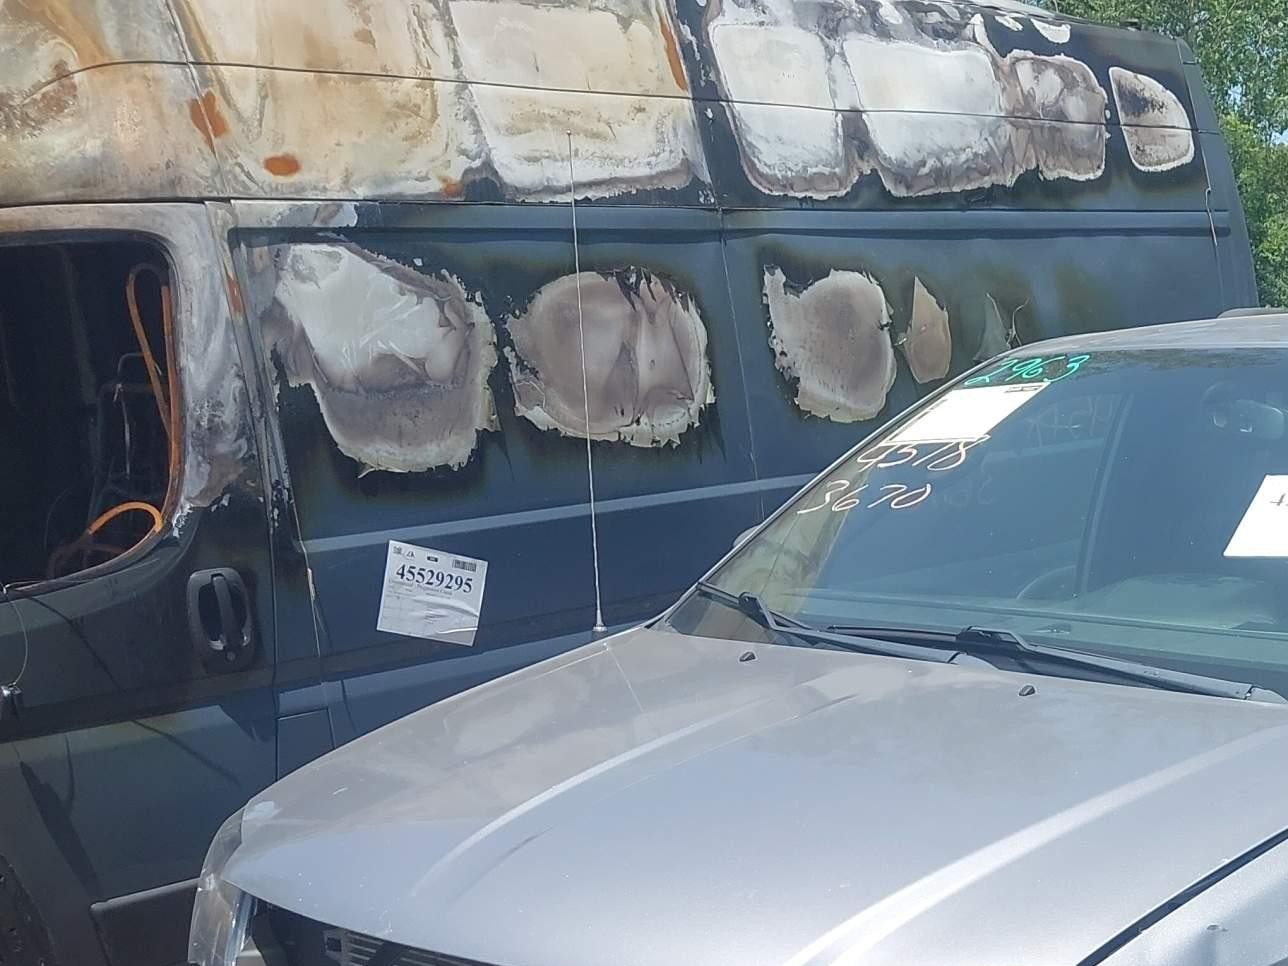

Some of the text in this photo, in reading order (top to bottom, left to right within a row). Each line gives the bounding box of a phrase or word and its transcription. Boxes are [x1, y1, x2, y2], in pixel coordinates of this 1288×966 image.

[964, 354, 1090, 386] 2963
[797, 480, 932, 515] 3670
[396, 564, 472, 593] 45529295
